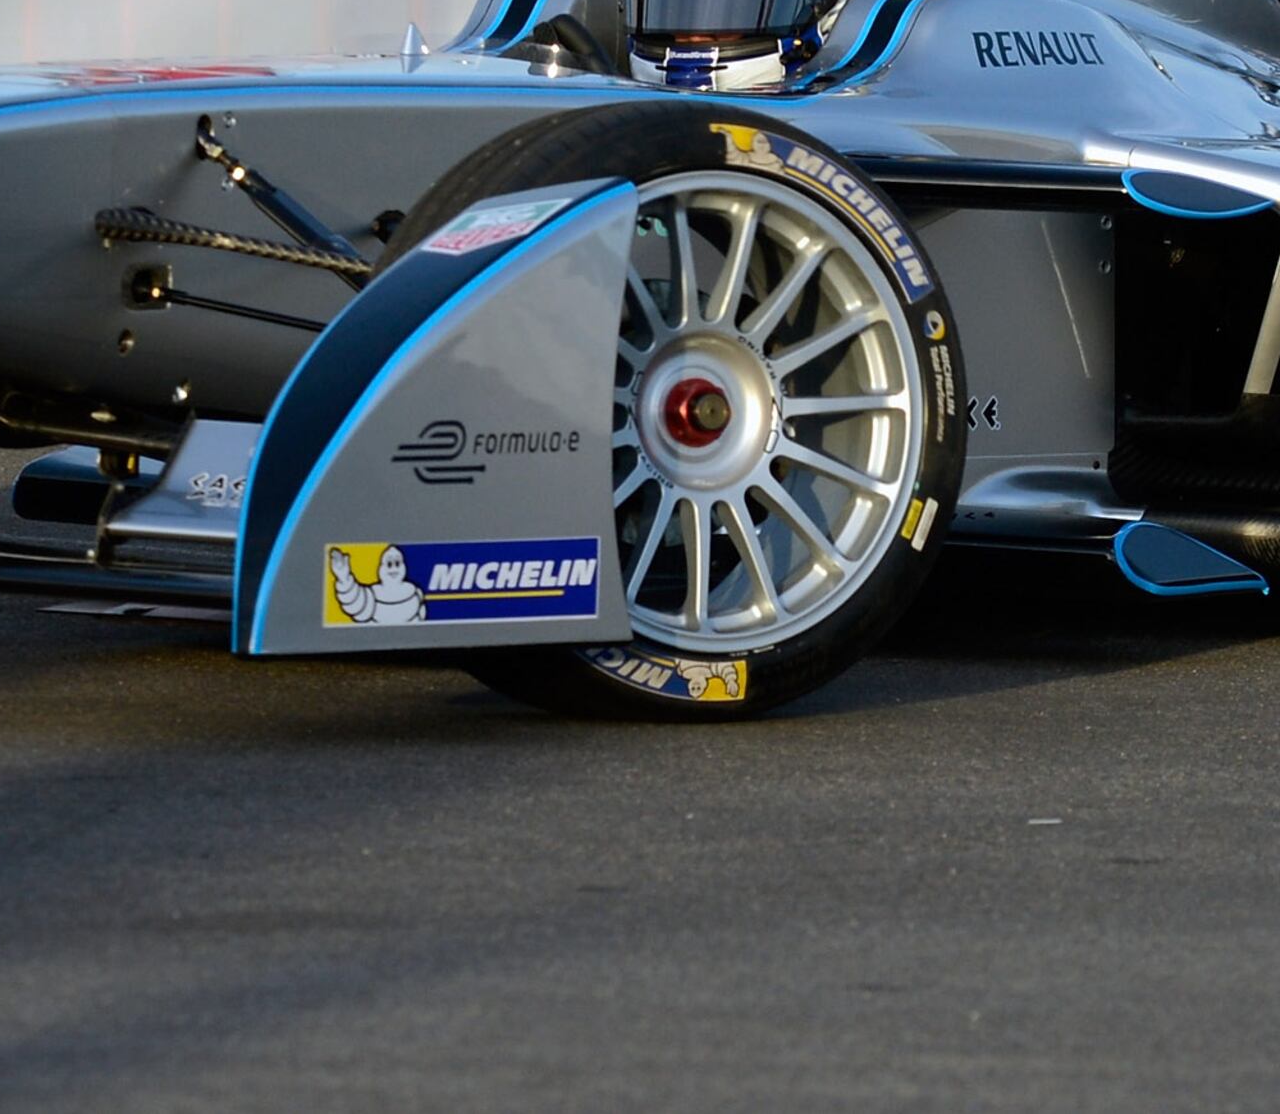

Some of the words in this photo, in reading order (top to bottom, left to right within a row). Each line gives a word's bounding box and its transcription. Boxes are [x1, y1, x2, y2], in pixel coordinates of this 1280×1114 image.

[972, 31, 1105, 68] RENAULT
[785, 146, 930, 287] MICHELIN
[939, 344, 956, 416] MICHELIN
[428, 558, 597, 592] MICHELIN
